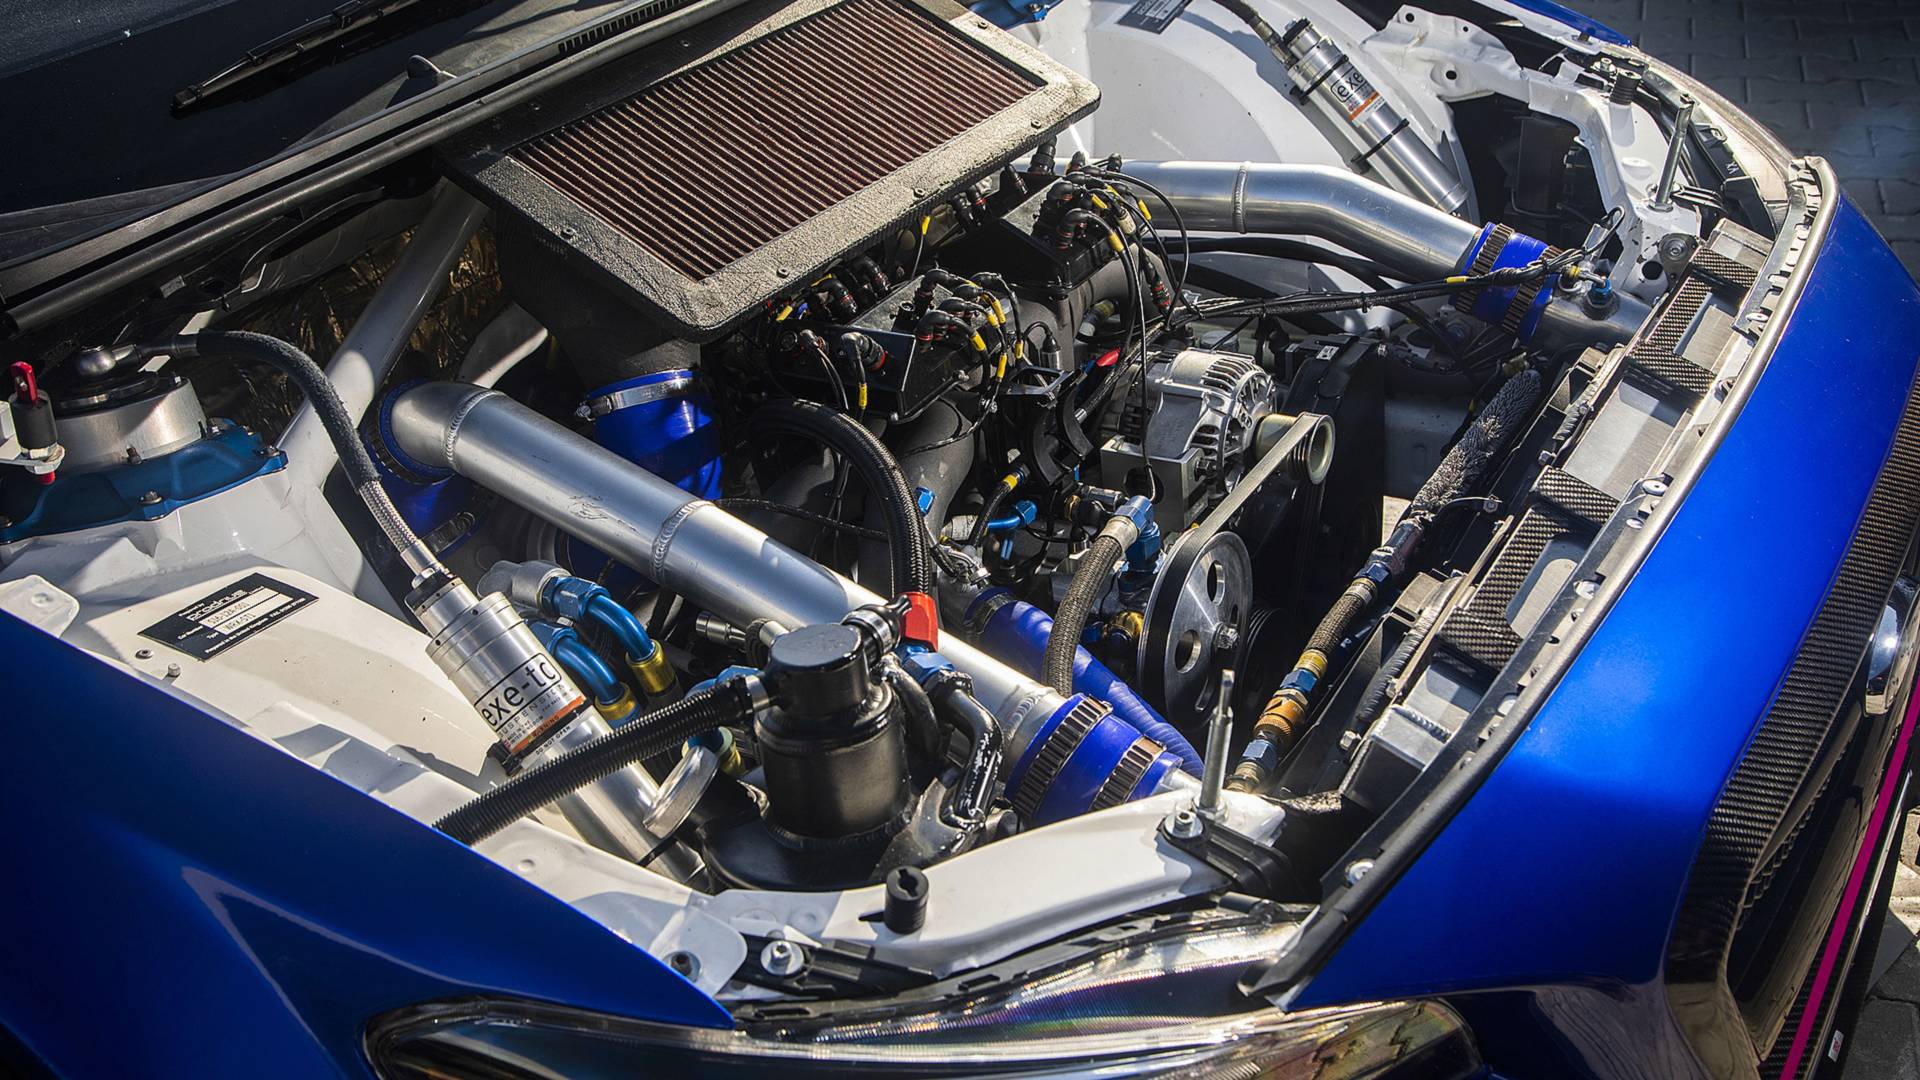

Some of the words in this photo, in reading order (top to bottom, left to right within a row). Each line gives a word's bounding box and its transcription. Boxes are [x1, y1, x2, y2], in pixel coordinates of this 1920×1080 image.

[1337, 72, 1363, 97] exe
[481, 662, 556, 726] exe-tc
[555, 726, 571, 739] OPEN
